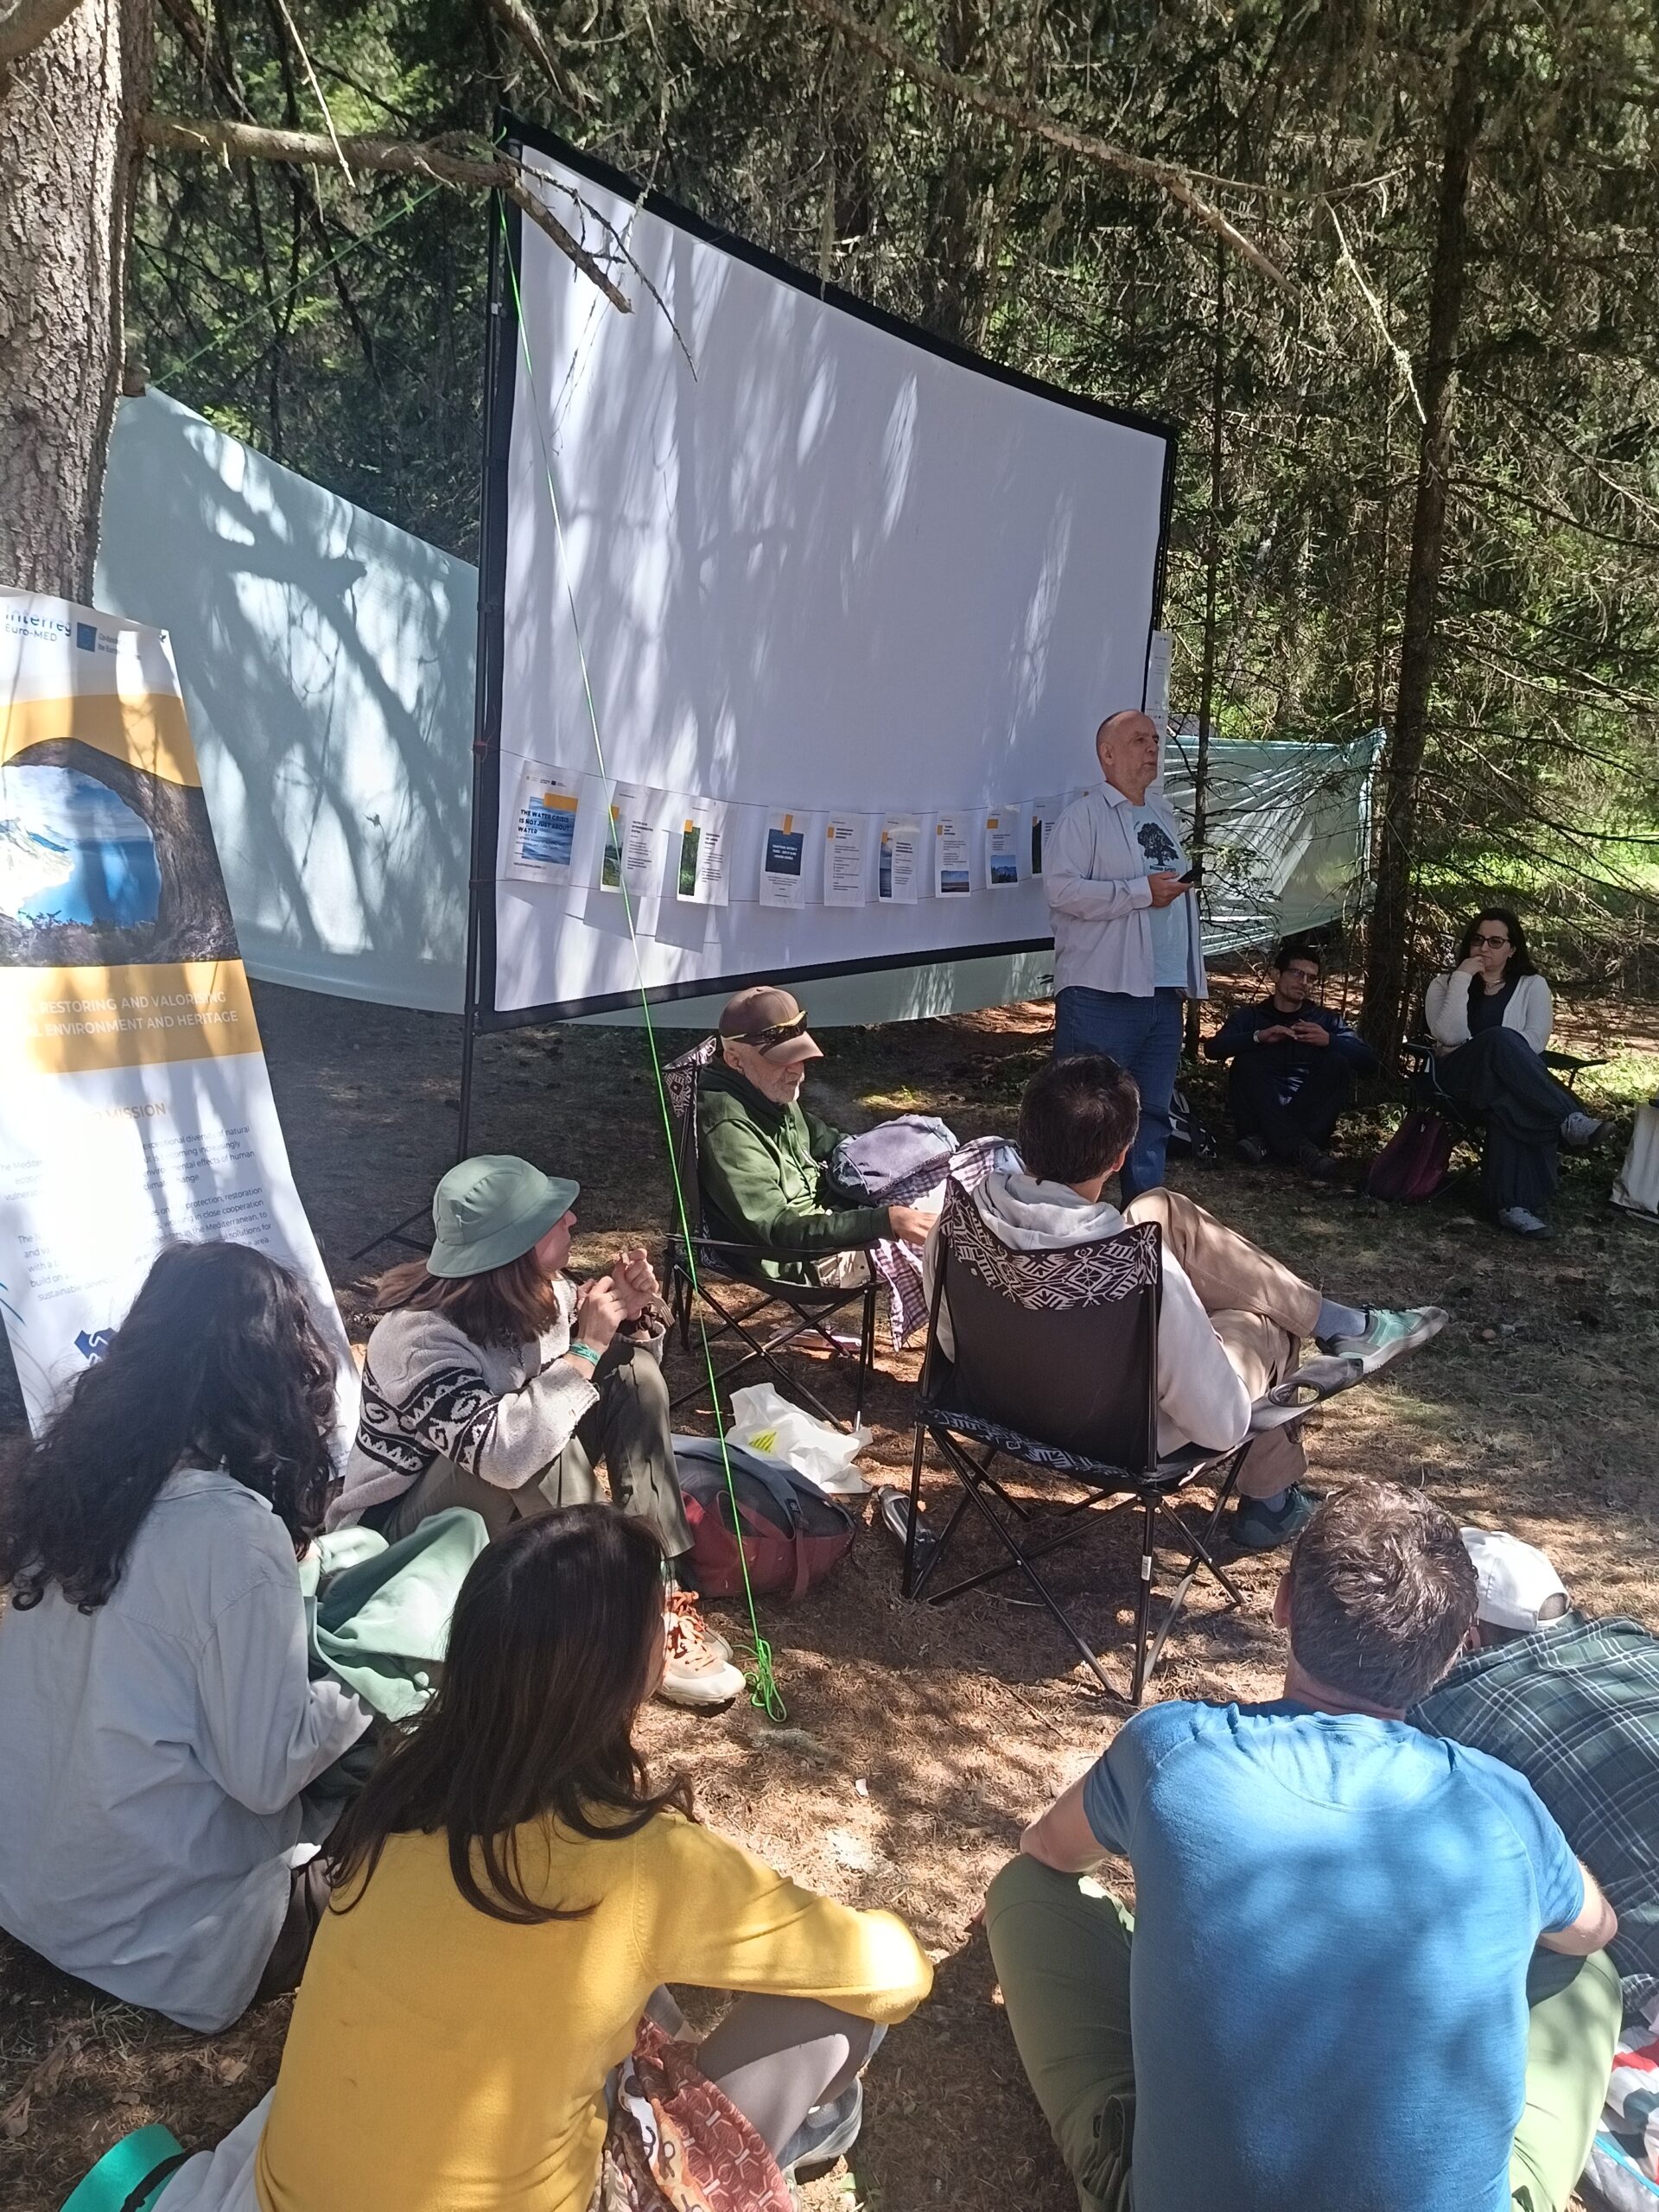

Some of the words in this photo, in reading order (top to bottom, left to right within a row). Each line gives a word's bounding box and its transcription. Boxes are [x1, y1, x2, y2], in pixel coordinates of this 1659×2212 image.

[5, 605, 71, 637] Interreg
[5, 623, 58, 642] Euro-MED
[531, 811, 550, 820] WATER
[551, 815, 569, 823] CRISIS
[537, 820, 550, 829] JUST
[551, 822, 569, 830] ABOUT
[40, 998, 118, 1014] RESTORING
[121, 995, 149, 1010] AND
[152, 991, 226, 1007] VALORISING
[46, 1018, 143, 1036] ENVIRONMENT
[147, 1015, 175, 1029] AND
[177, 1010, 238, 1027] HERITAGE
[105, 1103, 167, 1121] MISSION
[225, 1126, 250, 1136] natural
[230, 1150, 255, 1160] human
[225, 1187, 263, 1201] restoration
[202, 1210, 221, 1218] close
[222, 1199, 264, 1216] cooperation
[206, 1215, 259, 1231] Mediterranean,
[228, 1224, 261, 1237] solutions
[261, 1223, 271, 1231] for
